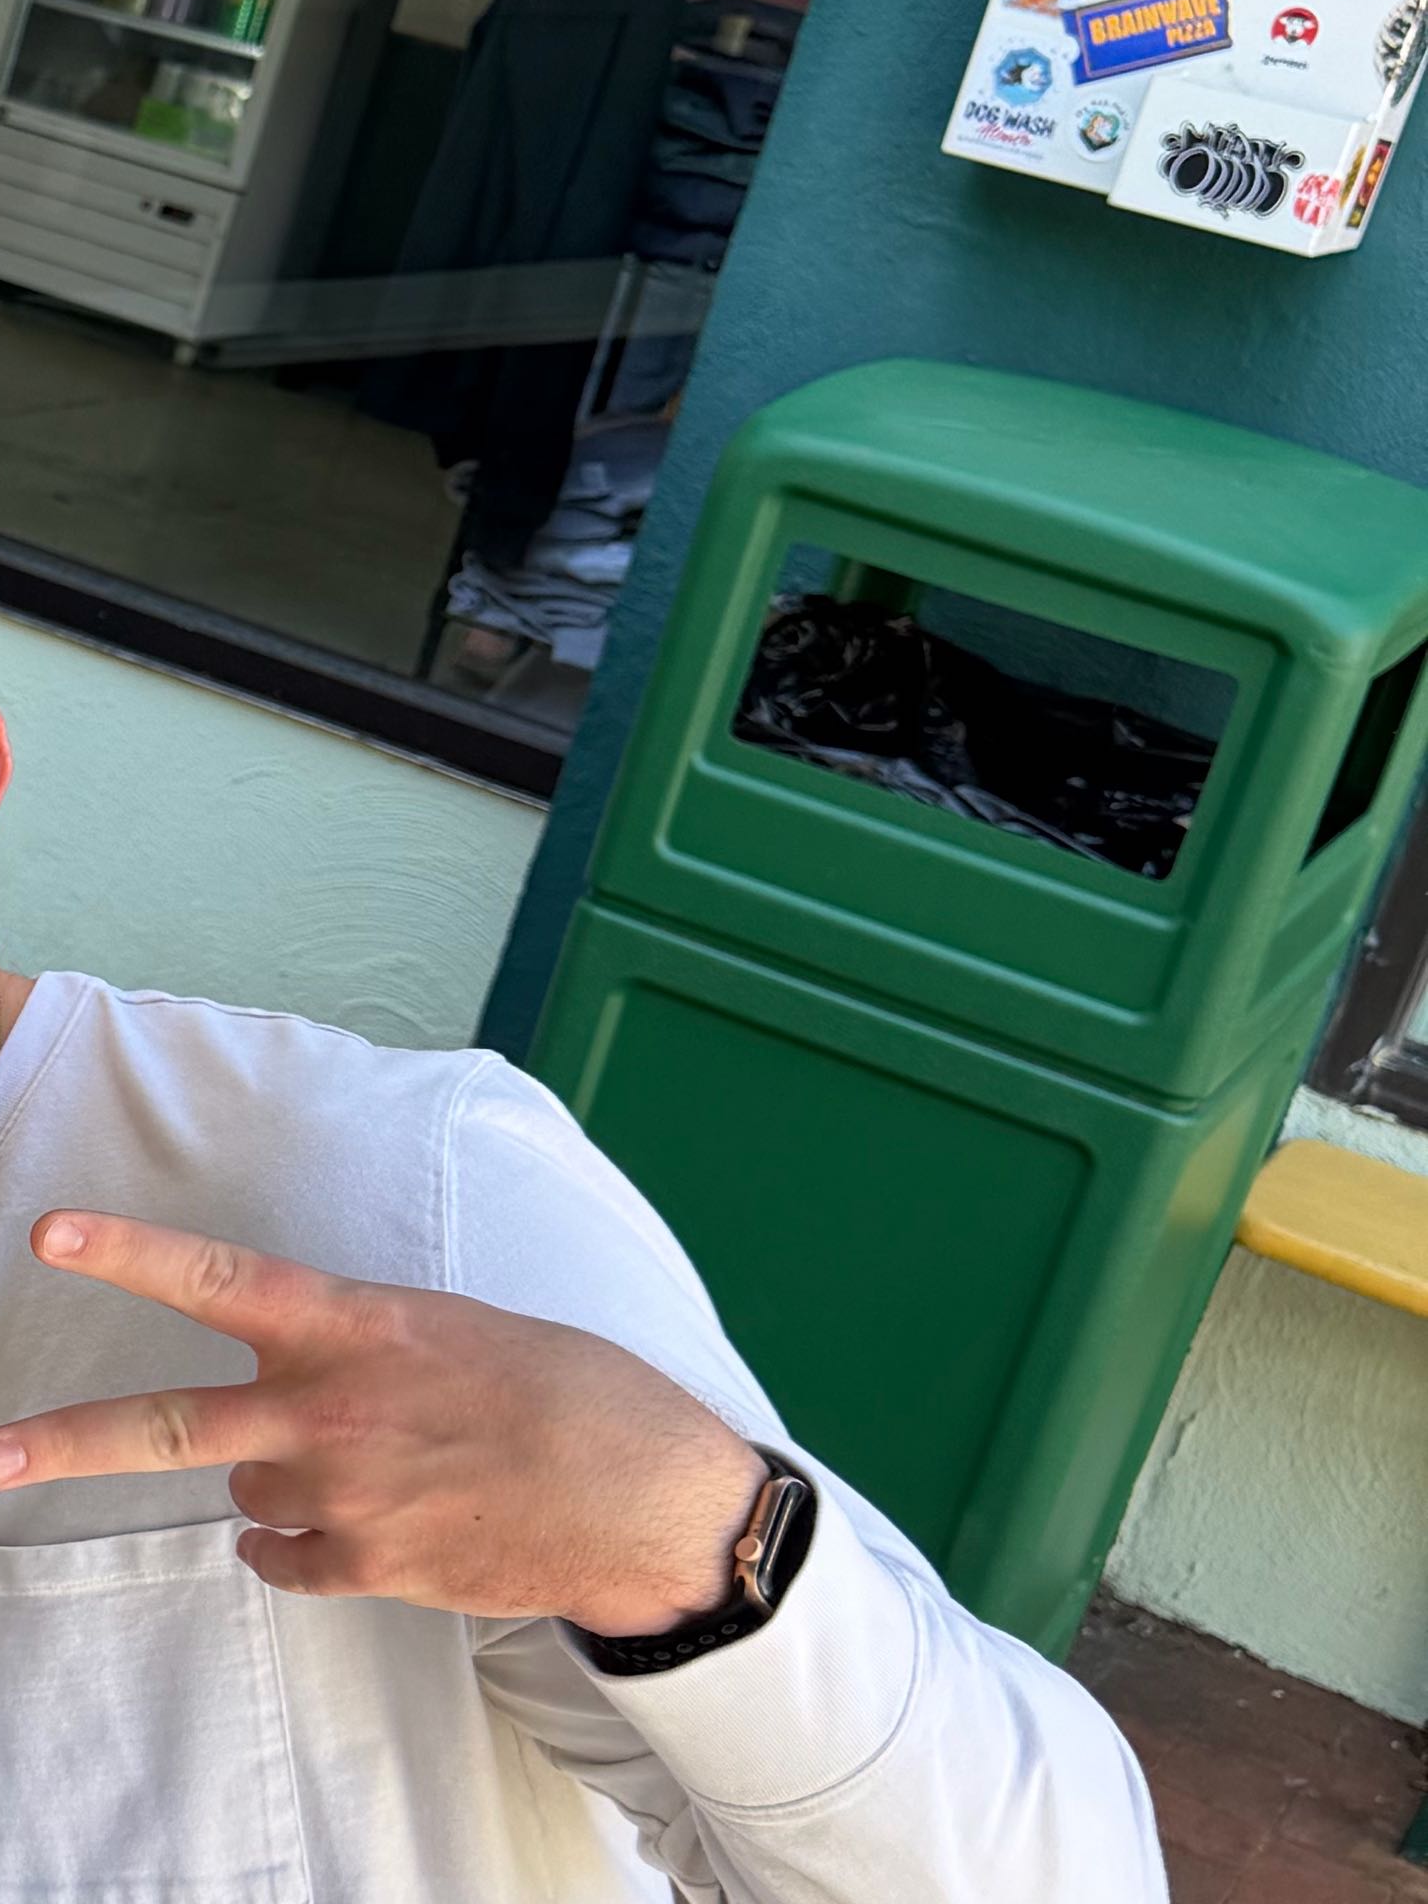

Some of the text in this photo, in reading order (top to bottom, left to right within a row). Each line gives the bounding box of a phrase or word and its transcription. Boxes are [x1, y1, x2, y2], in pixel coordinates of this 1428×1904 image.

[1166, 18, 1216, 47] PIZZA
[964, 100, 1001, 124] DOG
[1005, 108, 1057, 138] WASH
